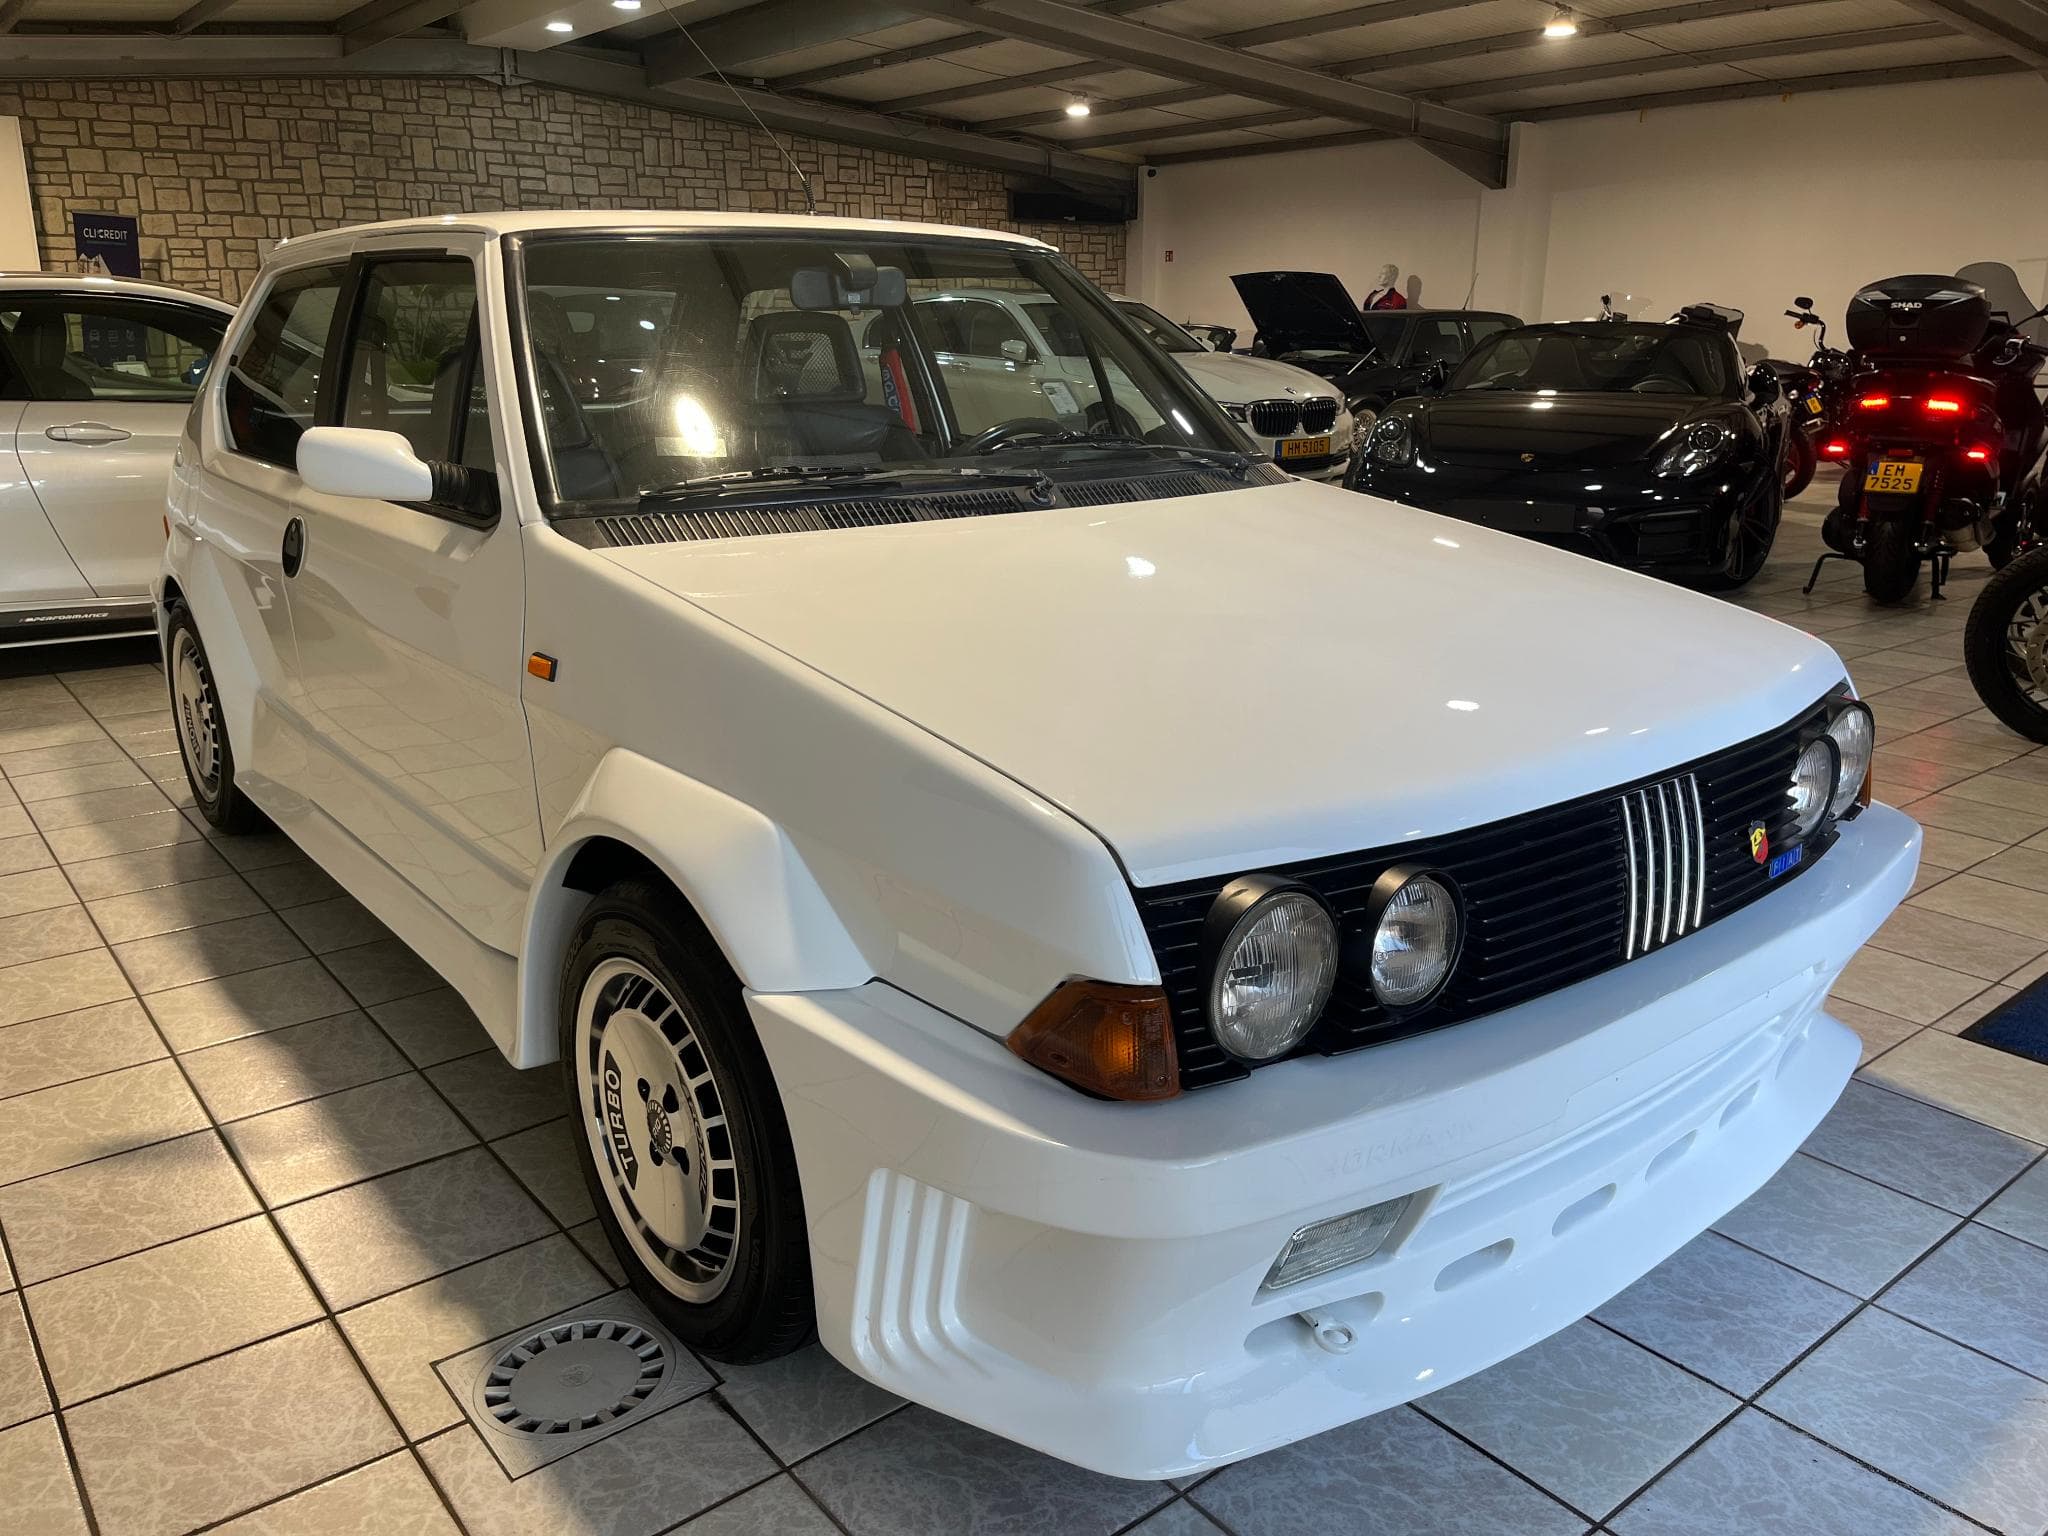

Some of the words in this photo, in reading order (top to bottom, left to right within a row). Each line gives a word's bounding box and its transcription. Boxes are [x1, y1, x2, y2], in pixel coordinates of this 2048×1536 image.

[1287, 442, 1300, 455] HM
[1302, 440, 1324, 453] 5105
[1871, 477, 1912, 490] 7525
[605, 1069, 634, 1170] TURBO
